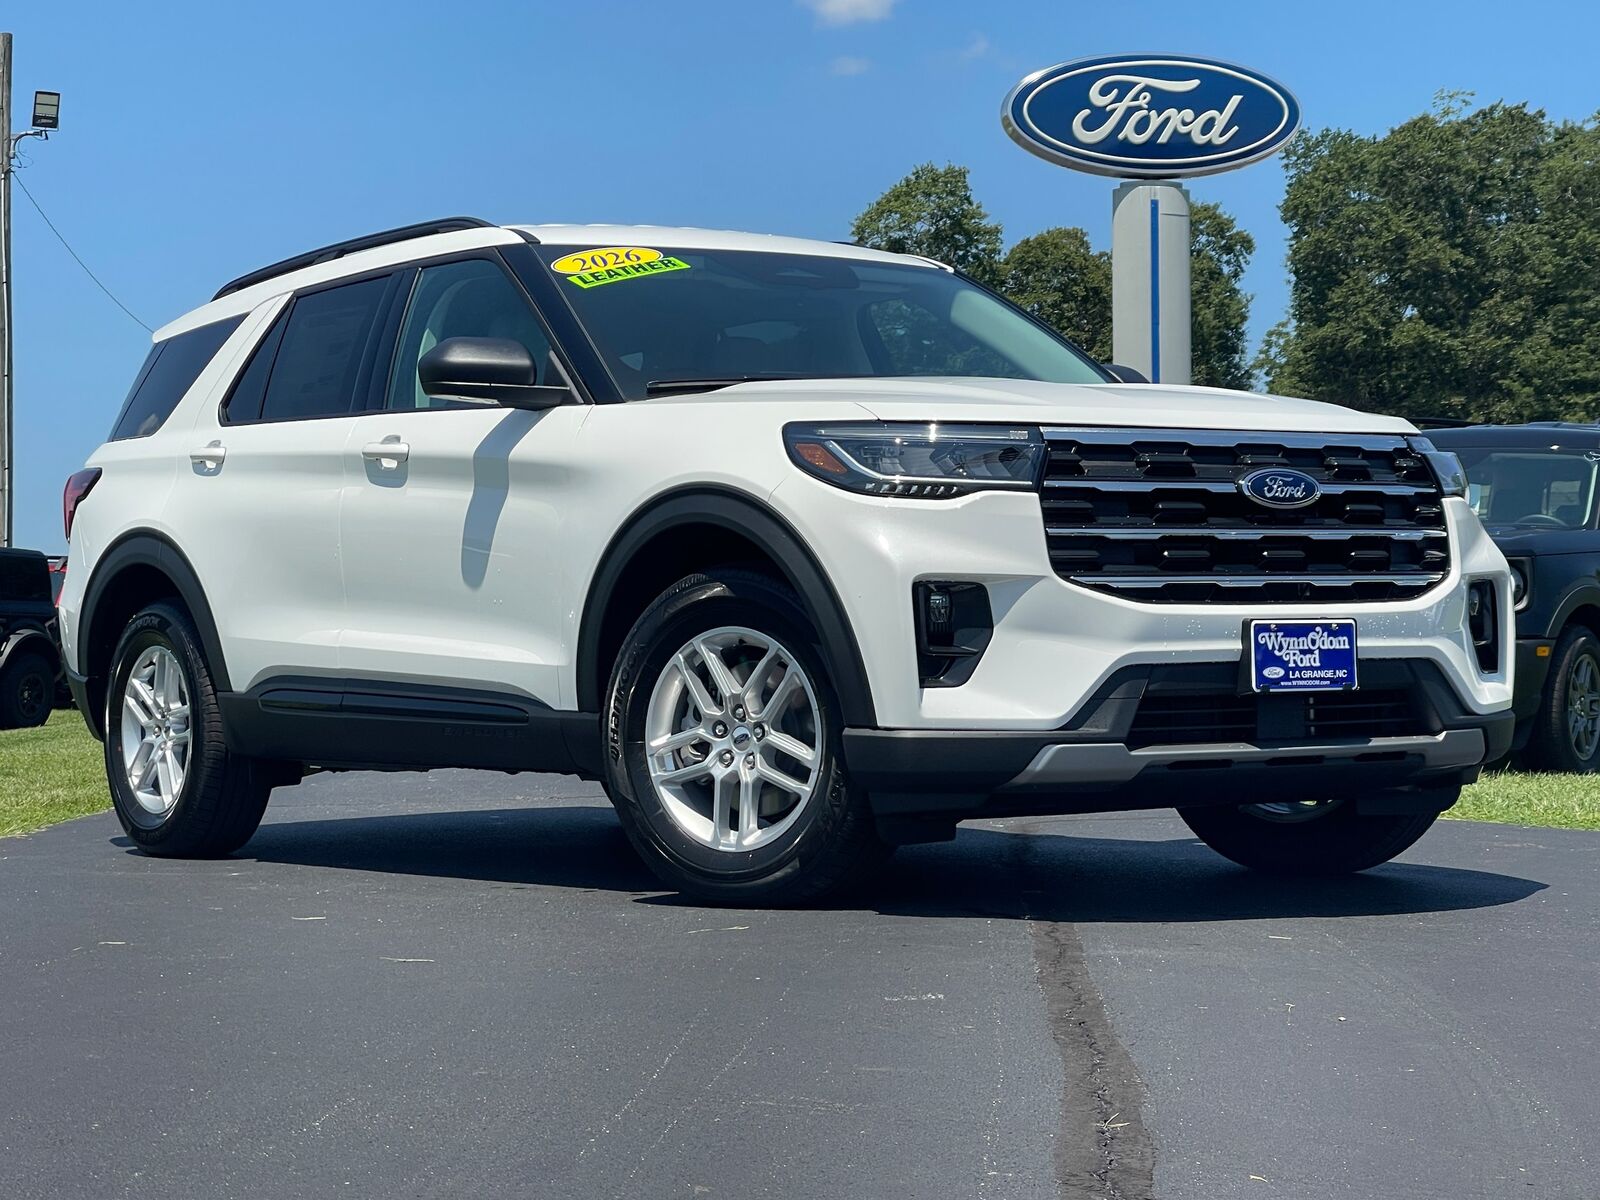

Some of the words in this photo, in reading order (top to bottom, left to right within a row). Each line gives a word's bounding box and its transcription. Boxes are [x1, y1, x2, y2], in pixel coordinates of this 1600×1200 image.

[1072, 74, 1244, 145] Ford
[572, 249, 641, 271] 2026
[577, 259, 678, 285] LEATHER
[1264, 475, 1305, 498] Ford
[1282, 649, 1321, 667] Ford
[1289, 670, 1301, 679] LA
